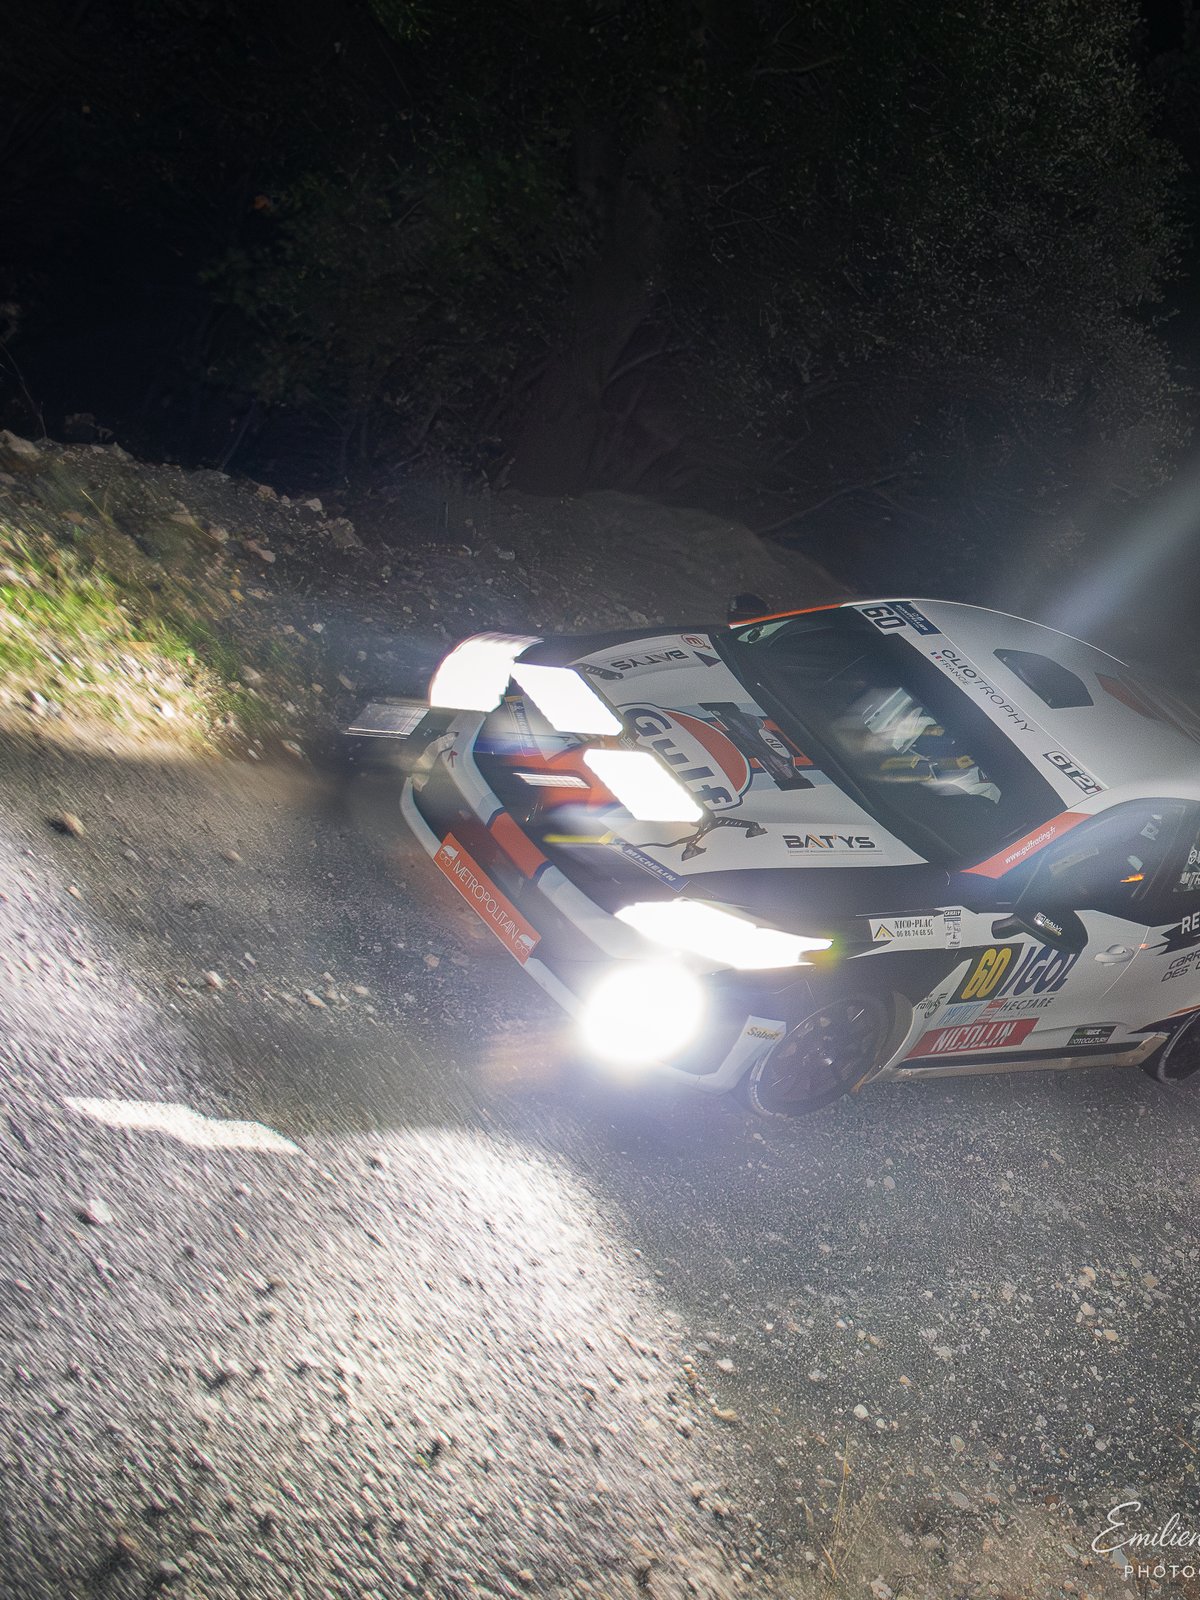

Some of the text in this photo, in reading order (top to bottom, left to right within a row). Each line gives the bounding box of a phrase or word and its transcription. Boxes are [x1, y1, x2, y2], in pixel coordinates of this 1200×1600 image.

[862, 606, 907, 629] 60
[940, 658, 970, 686] FRANCE
[624, 707, 733, 804] Gulf
[765, 738, 783, 750] 60
[625, 848, 677, 882] MICHELIN
[452, 860, 520, 939] METROPOLITAIN
[961, 948, 1012, 1000] 60
[999, 945, 1082, 997] IGOL
[930, 1021, 1017, 1052] NICOLLIN
